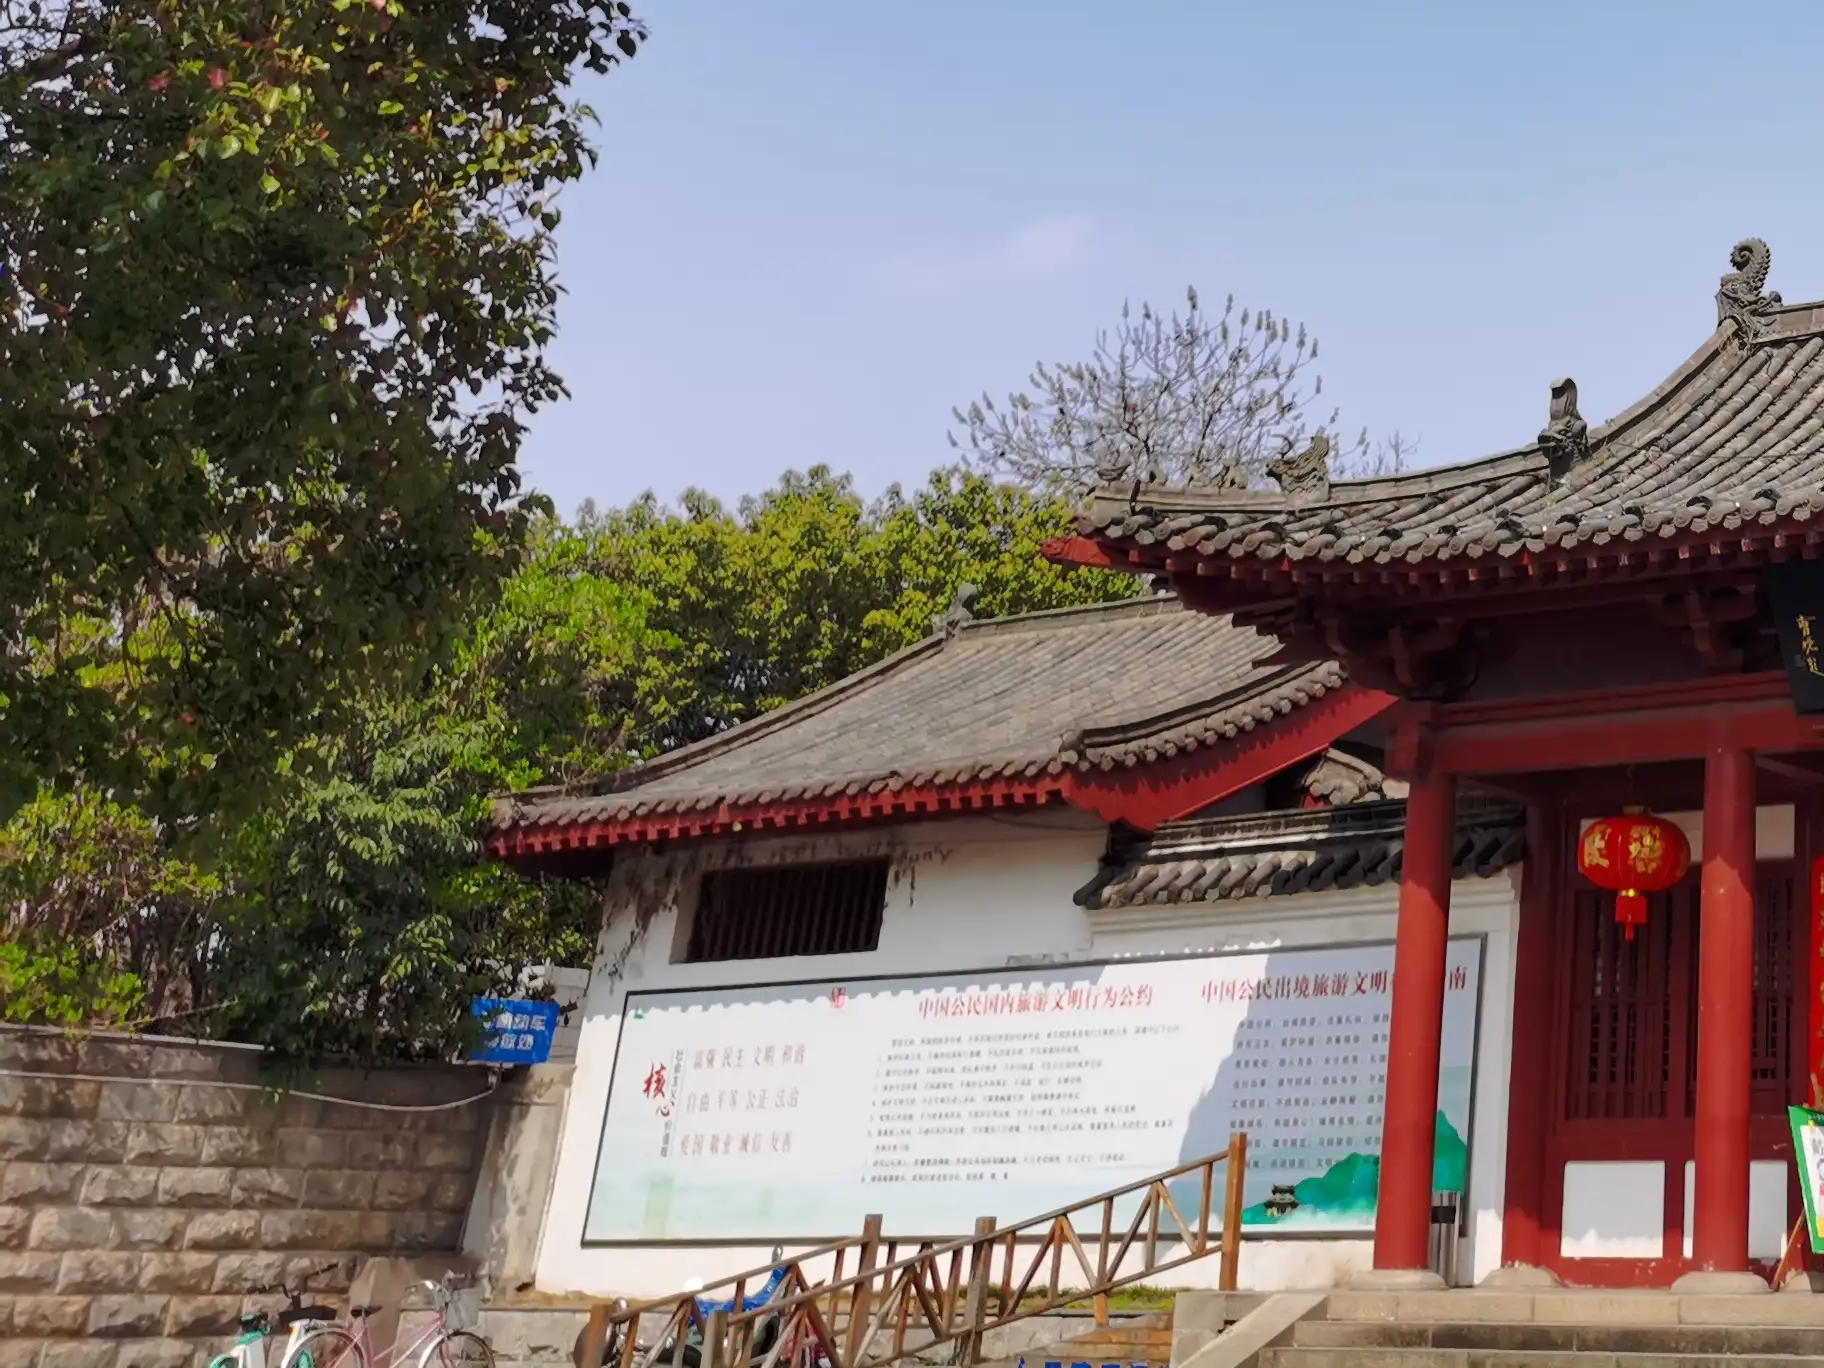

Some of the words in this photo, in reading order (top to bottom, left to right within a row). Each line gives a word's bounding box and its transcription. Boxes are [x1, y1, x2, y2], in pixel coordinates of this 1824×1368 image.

[918, 983, 1153, 1019] 中国公民国内旅游文明行为公约
